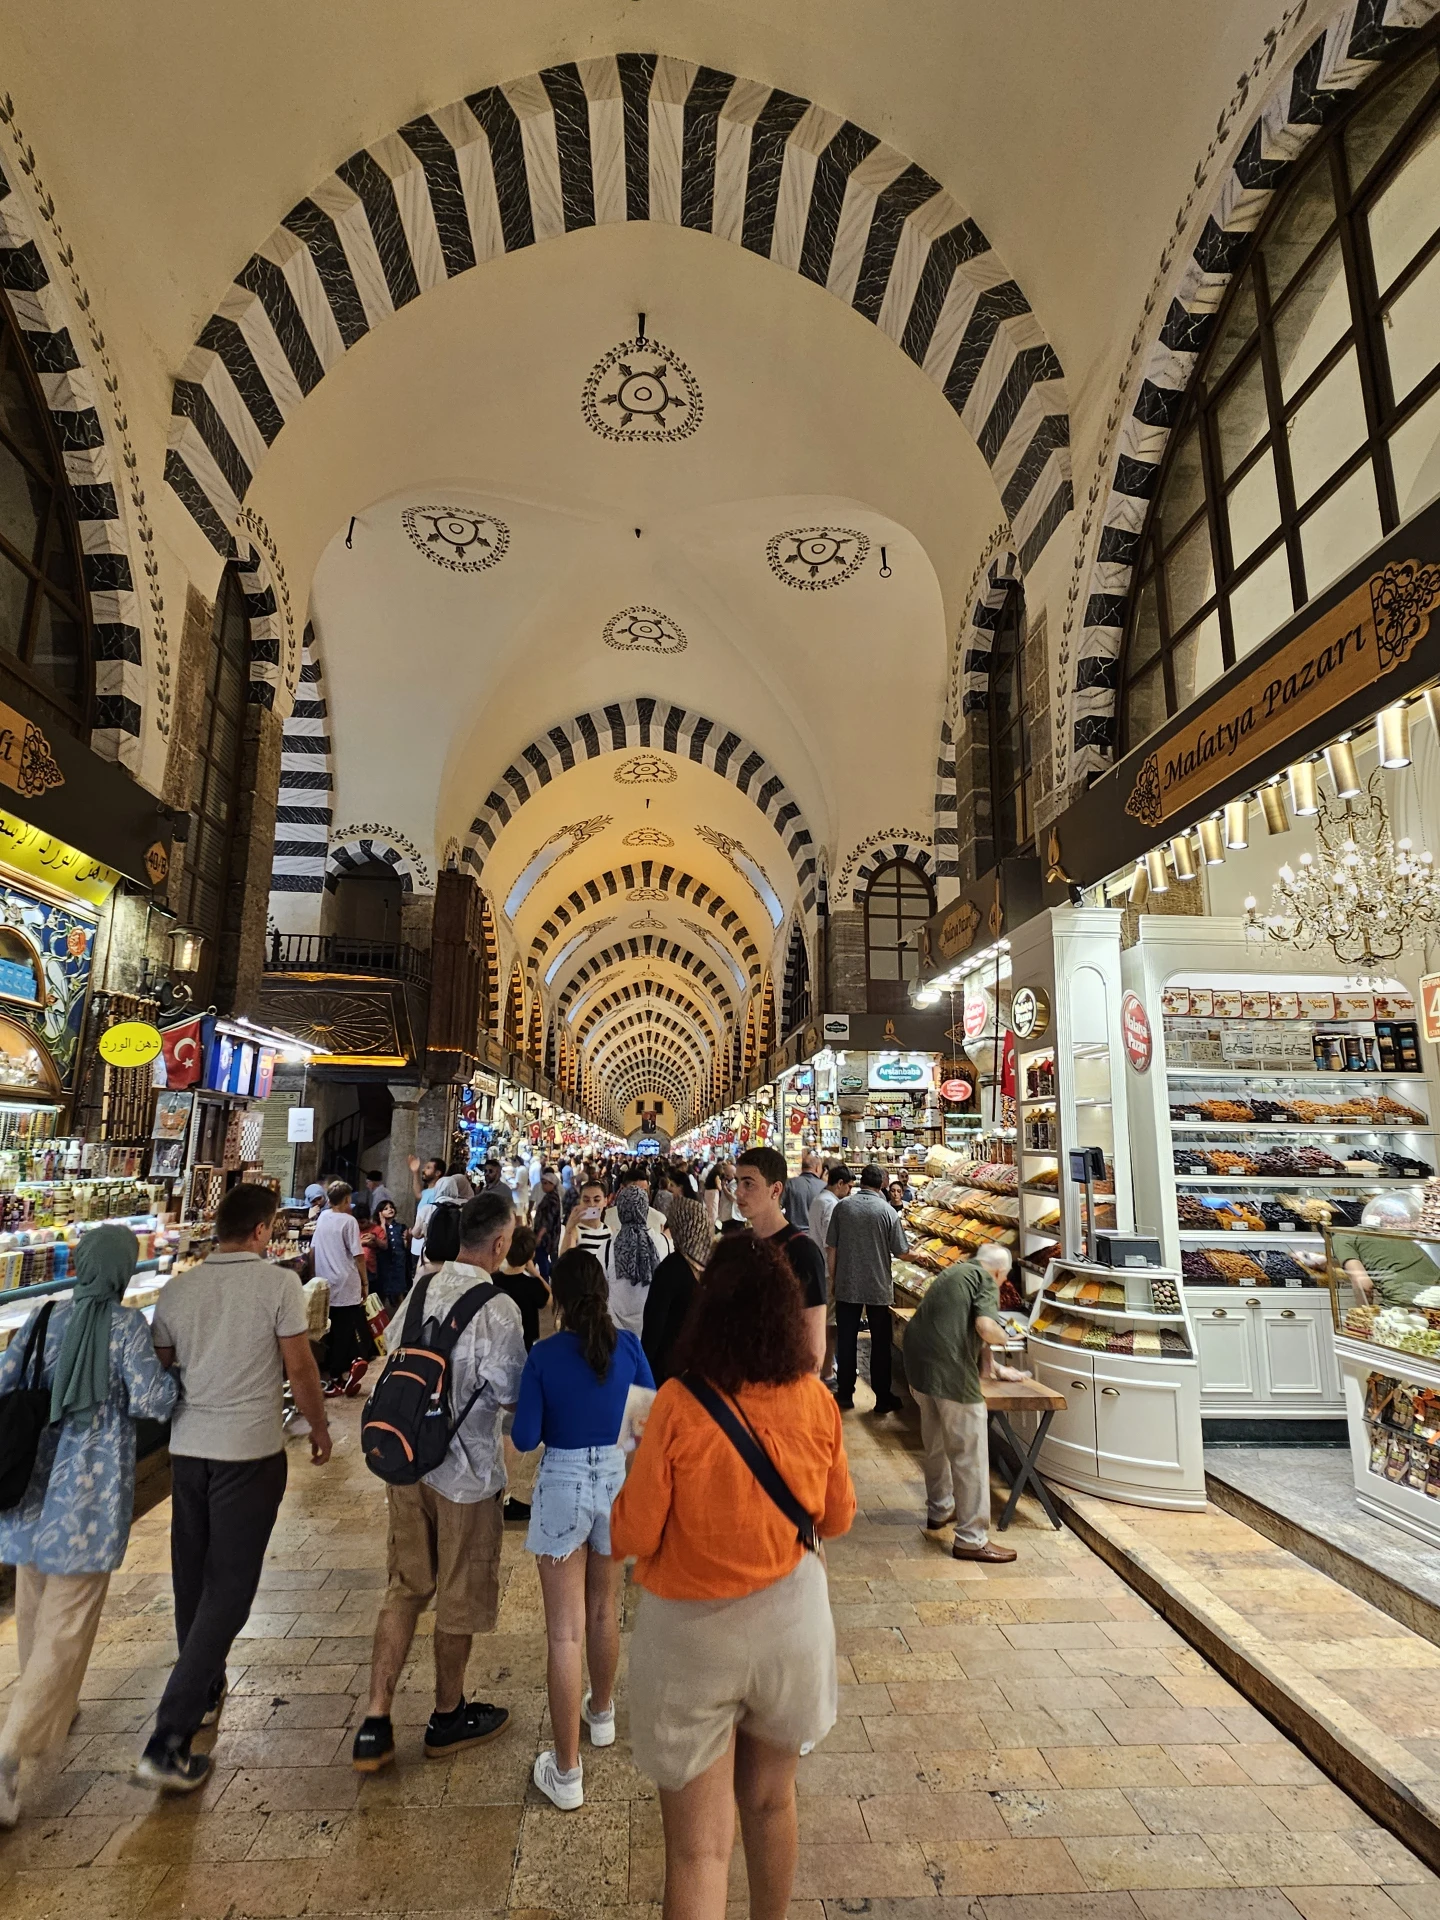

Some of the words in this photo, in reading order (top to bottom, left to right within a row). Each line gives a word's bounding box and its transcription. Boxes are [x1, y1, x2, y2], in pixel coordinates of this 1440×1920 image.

[1164, 706, 1256, 790] Malatya
[1262, 623, 1366, 719] Pazarı
[39, 838, 81, 870] الورد
[75, 860, 110, 883] دهن
[102, 1037, 131, 1053] الورد
[135, 1039, 159, 1052] دهن
